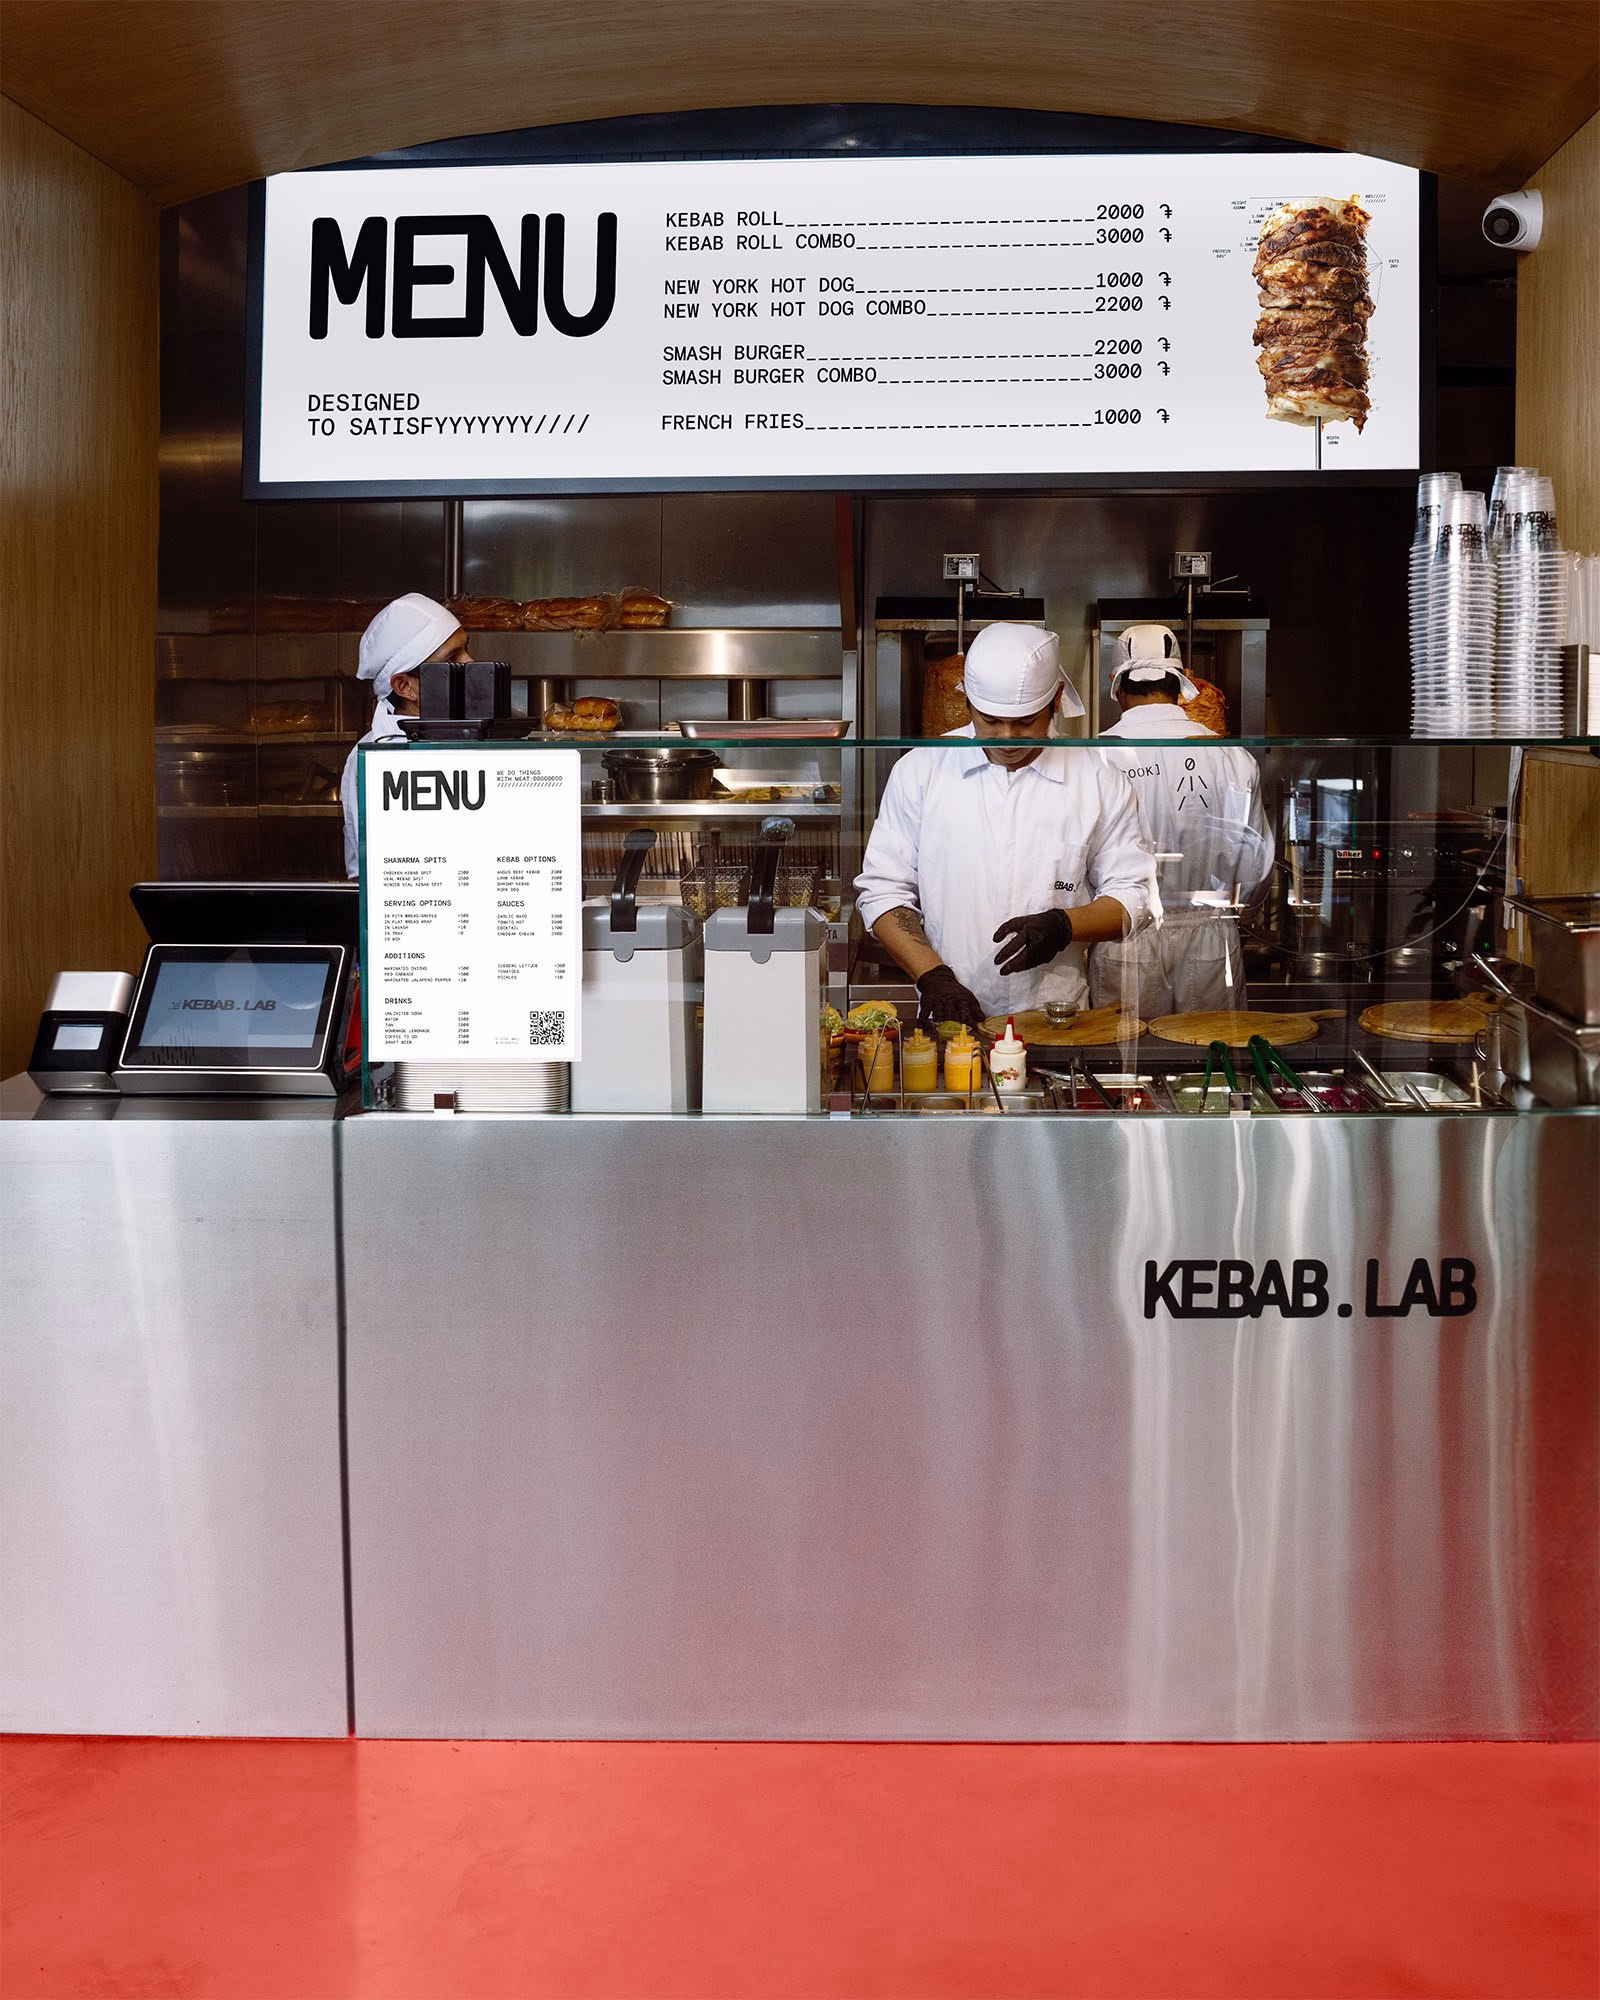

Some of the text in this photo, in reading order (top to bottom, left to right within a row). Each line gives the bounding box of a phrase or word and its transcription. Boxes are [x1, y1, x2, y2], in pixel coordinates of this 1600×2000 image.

[667, 212, 724, 227] KEBAB
[666, 236, 723, 251] KEBAB
[737, 235, 782, 249] ROLL
[309, 212, 617, 339] MENU
[665, 280, 700, 294] NEW
[712, 279, 758, 294] YORK
[772, 278, 806, 293] HOT
[665, 304, 699, 318] NEW
[712, 303, 757, 317] YORK
[771, 302, 805, 316] HOT
[819, 301, 853, 316] DOG
[664, 346, 721, 361] SMASH
[663, 370, 721, 385] SMASH
[734, 369, 804, 383] BURGER
[309, 393, 419, 411] DESIGNED
[308, 418, 334, 436] TO
[663, 415, 731, 430] FRENCH
[383, 770, 485, 811] MENU
[424, 856, 447, 864] SPITS
[384, 899, 452, 907] SERVING OPTIONS
[182, 999, 276, 1011] KEBAB.LAB
[1144, 1258, 1477, 1319] KEBAB.LAB
